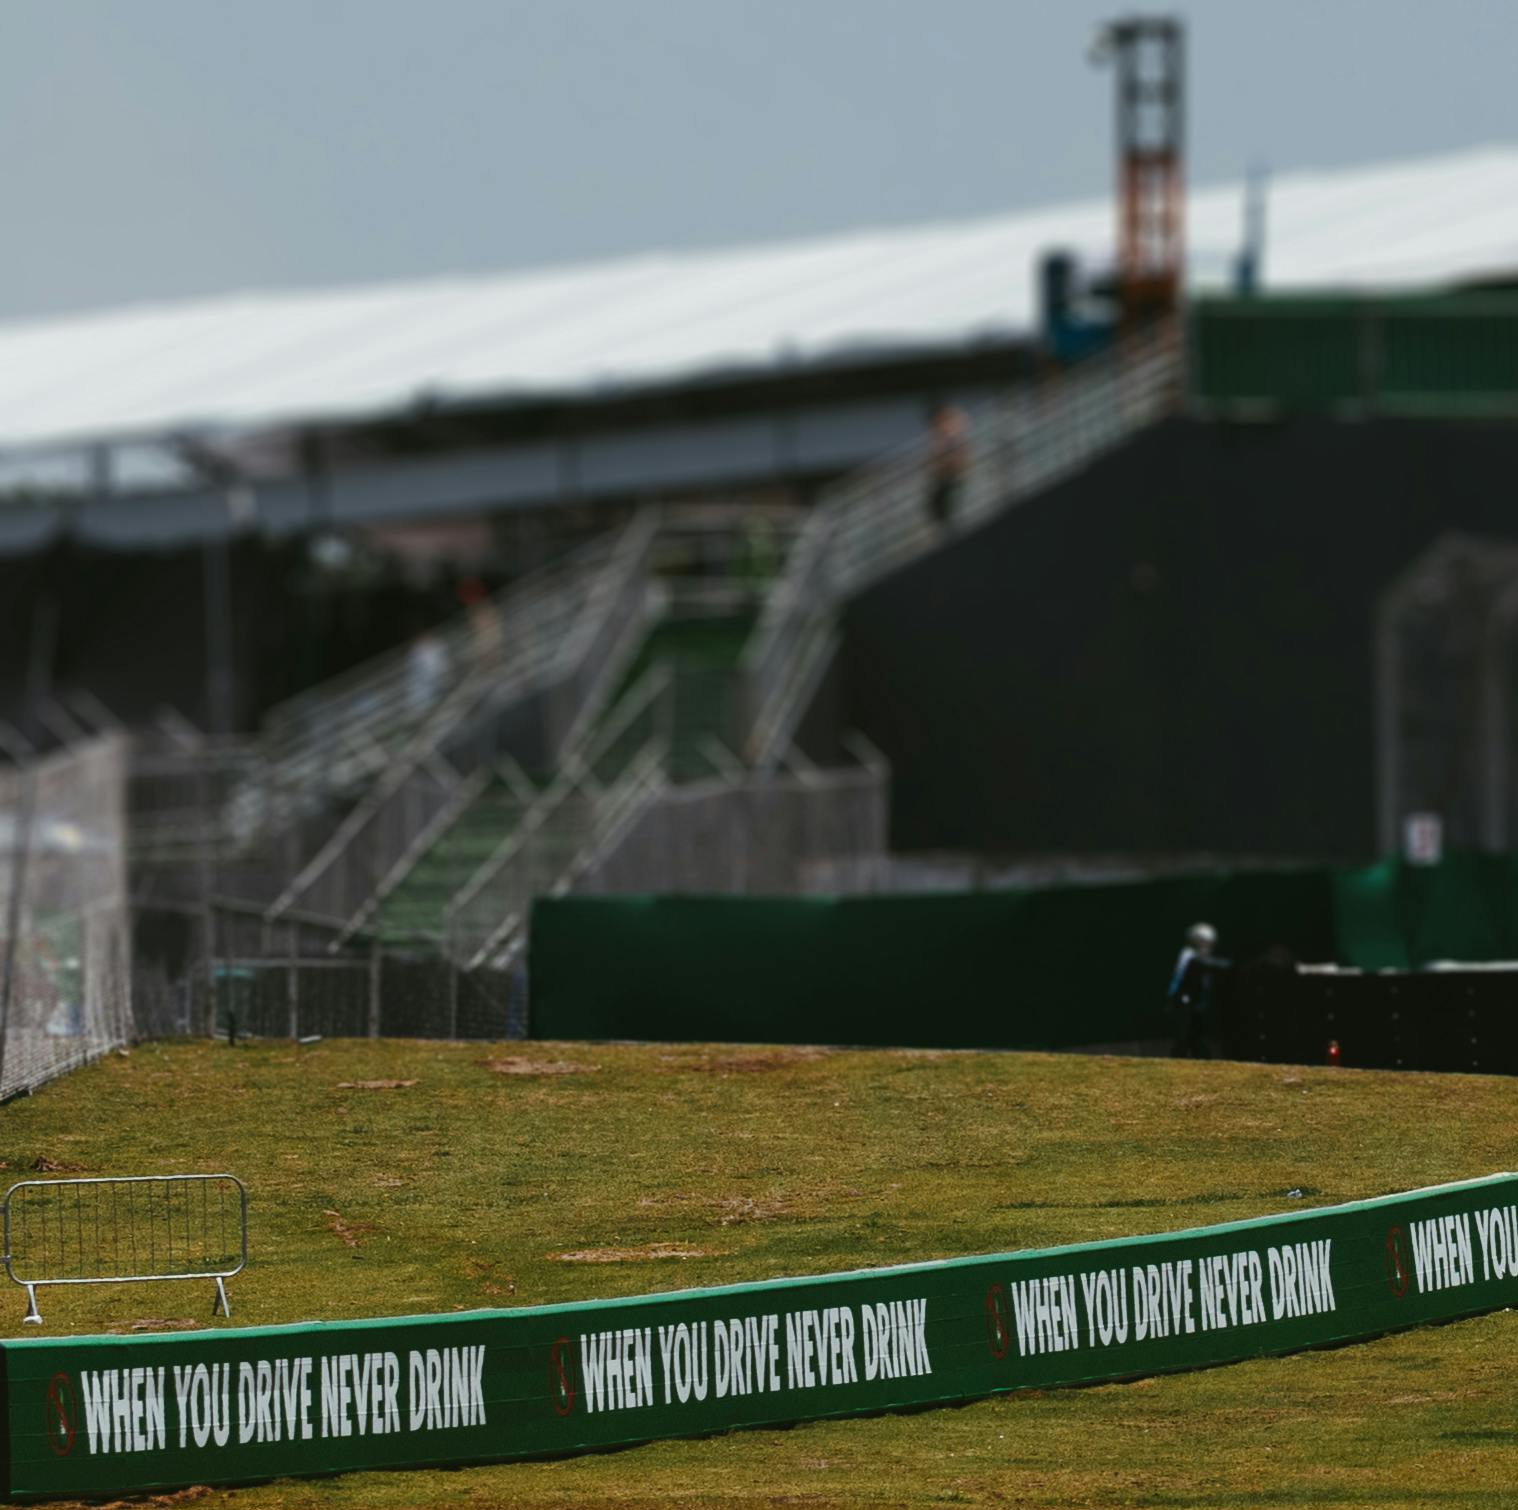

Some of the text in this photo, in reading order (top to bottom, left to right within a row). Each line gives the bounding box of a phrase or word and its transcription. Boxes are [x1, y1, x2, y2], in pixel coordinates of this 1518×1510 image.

[1011, 1239, 1336, 1357] WHEN YOU DRIVE NEVER DRINK
[1410, 1213, 1474, 1293] WHEN
[81, 1345, 487, 1455] WHEN YOU DRIVE NEVER DRINK
[580, 1298, 932, 1413] WHEN YOU DRIVE NEVER DRINK
